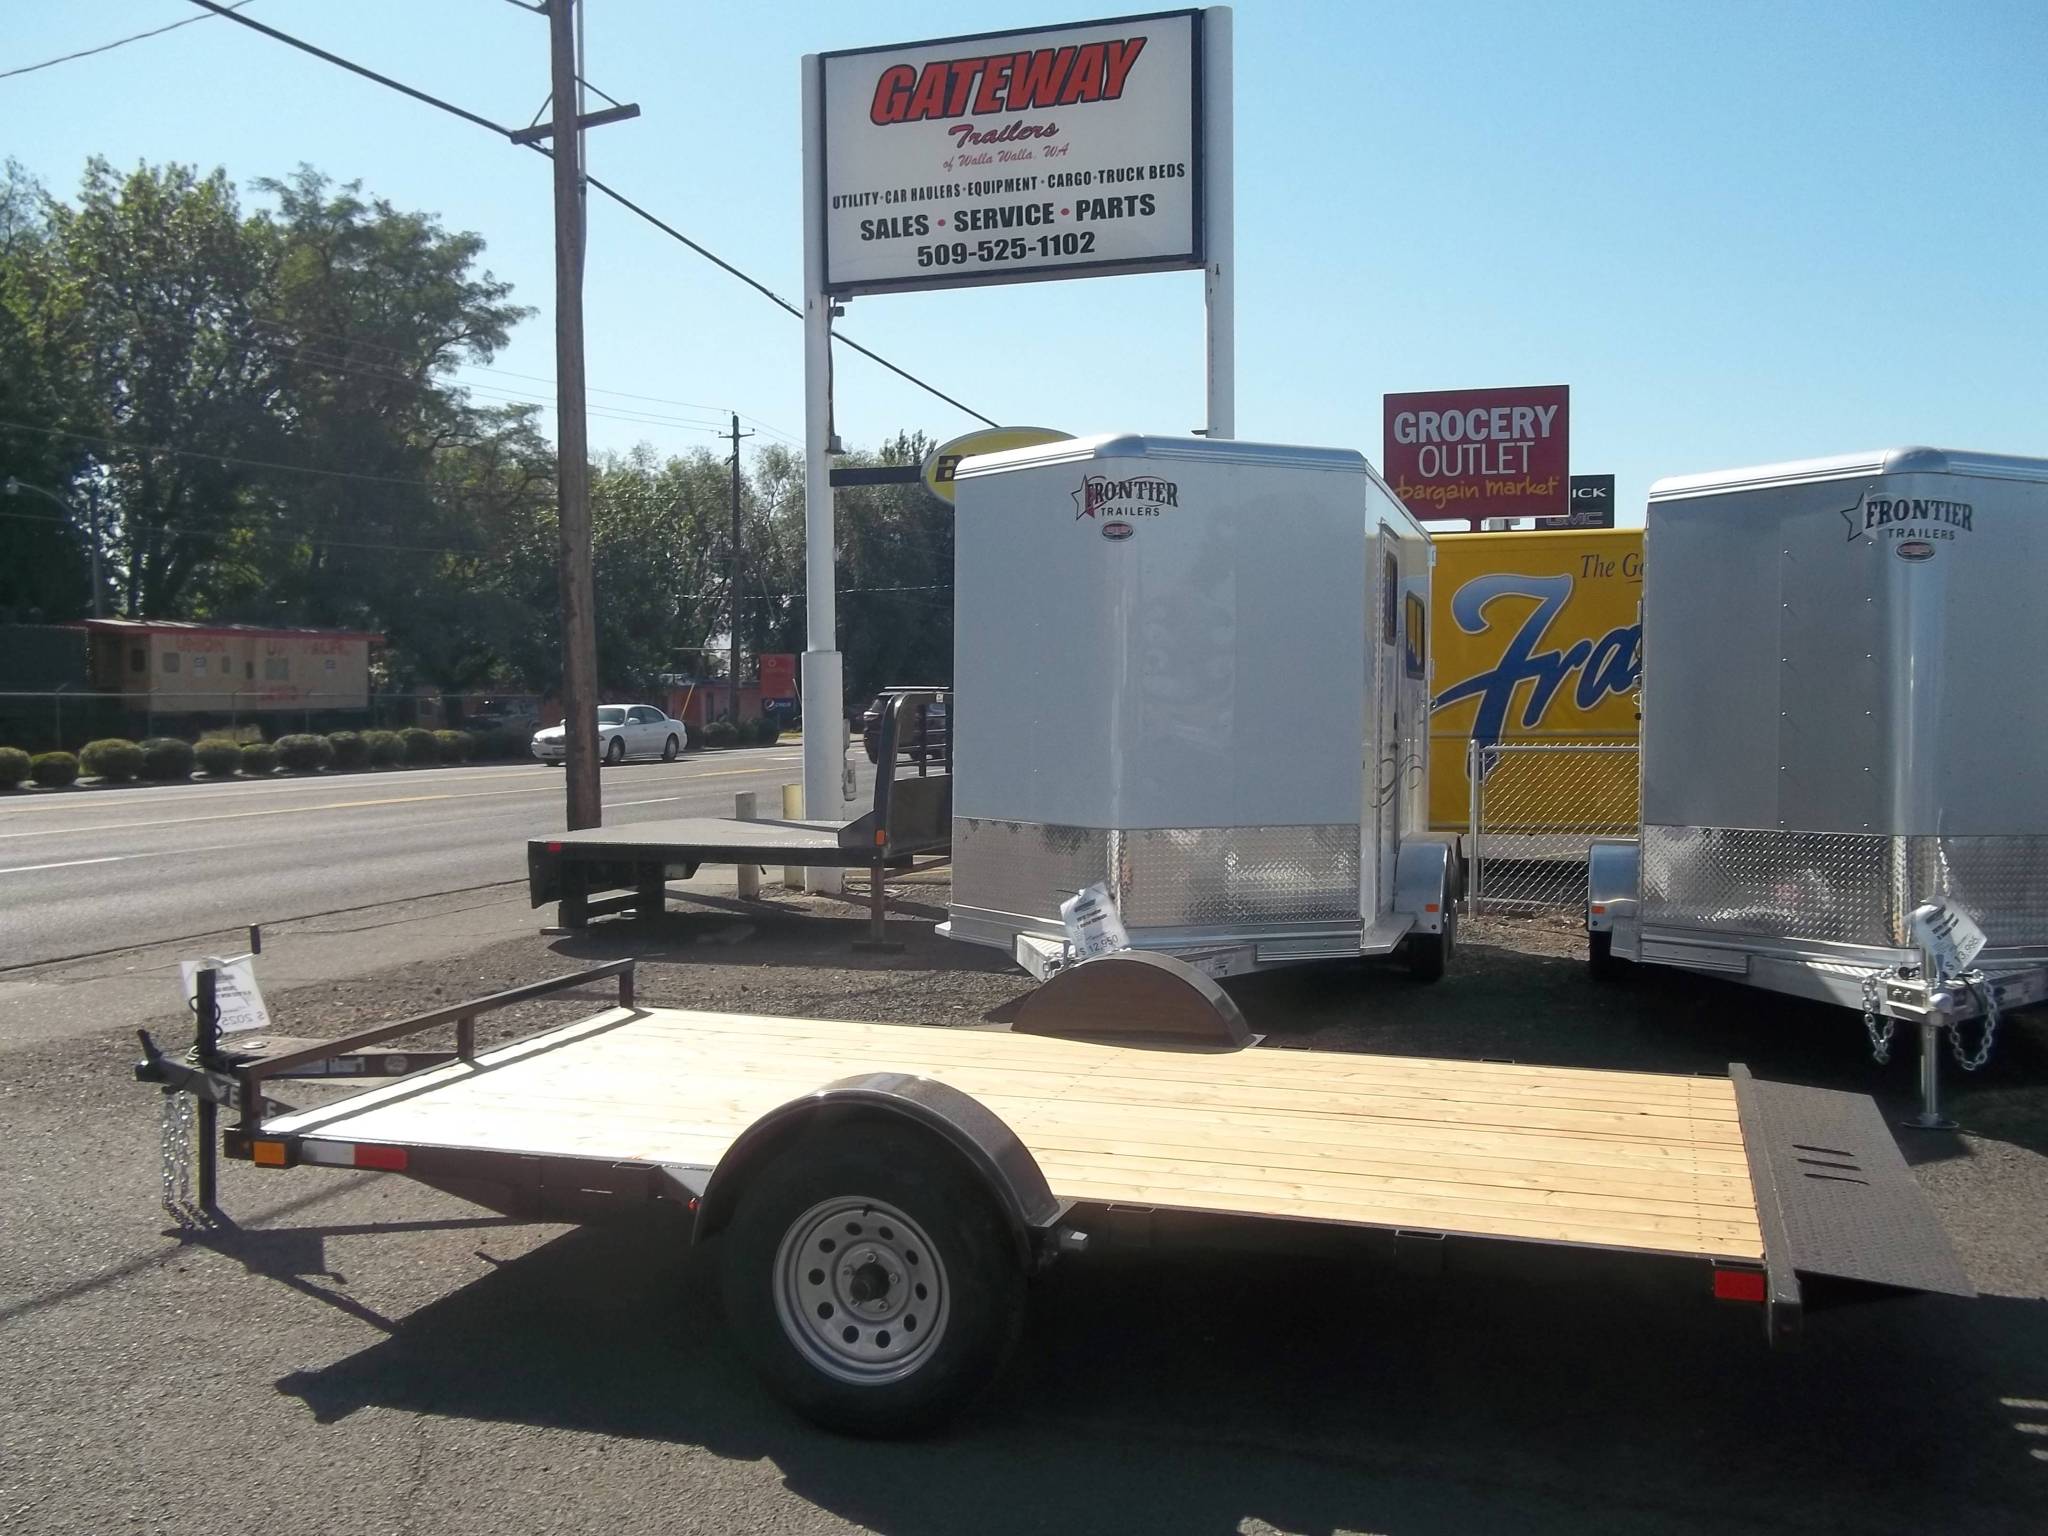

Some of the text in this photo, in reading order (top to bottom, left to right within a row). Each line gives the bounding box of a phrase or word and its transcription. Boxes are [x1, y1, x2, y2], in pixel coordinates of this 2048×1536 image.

[870, 36, 1148, 126] GATEWAY
[948, 120, 1060, 149] Trailers
[943, 157, 954, 173] of
[958, 153, 993, 167] Walla
[1043, 142, 1070, 158] WA
[833, 191, 879, 210] UTILITY
[911, 183, 960, 201] HAULERS
[967, 175, 1038, 197] EQUIPMENT
[1048, 171, 1092, 188] CARGO
[1098, 166, 1144, 184] TRUCK
[1149, 163, 1186, 180] BEDS
[860, 193, 1156, 241] SALES SERVICE PARTS
[917, 231, 1096, 267] 509-525-1102
[1394, 405, 1559, 444] GROCERY
[1418, 441, 1535, 478] OUTLET
[1087, 481, 1178, 508] FRONTIER
[1396, 475, 1559, 509] bargain market
[1101, 507, 1160, 517] TRAILERS
[1865, 499, 1972, 532] FRONTIER
[1887, 528, 1955, 541] TRAILERS
[1580, 552, 1644, 578] The G
